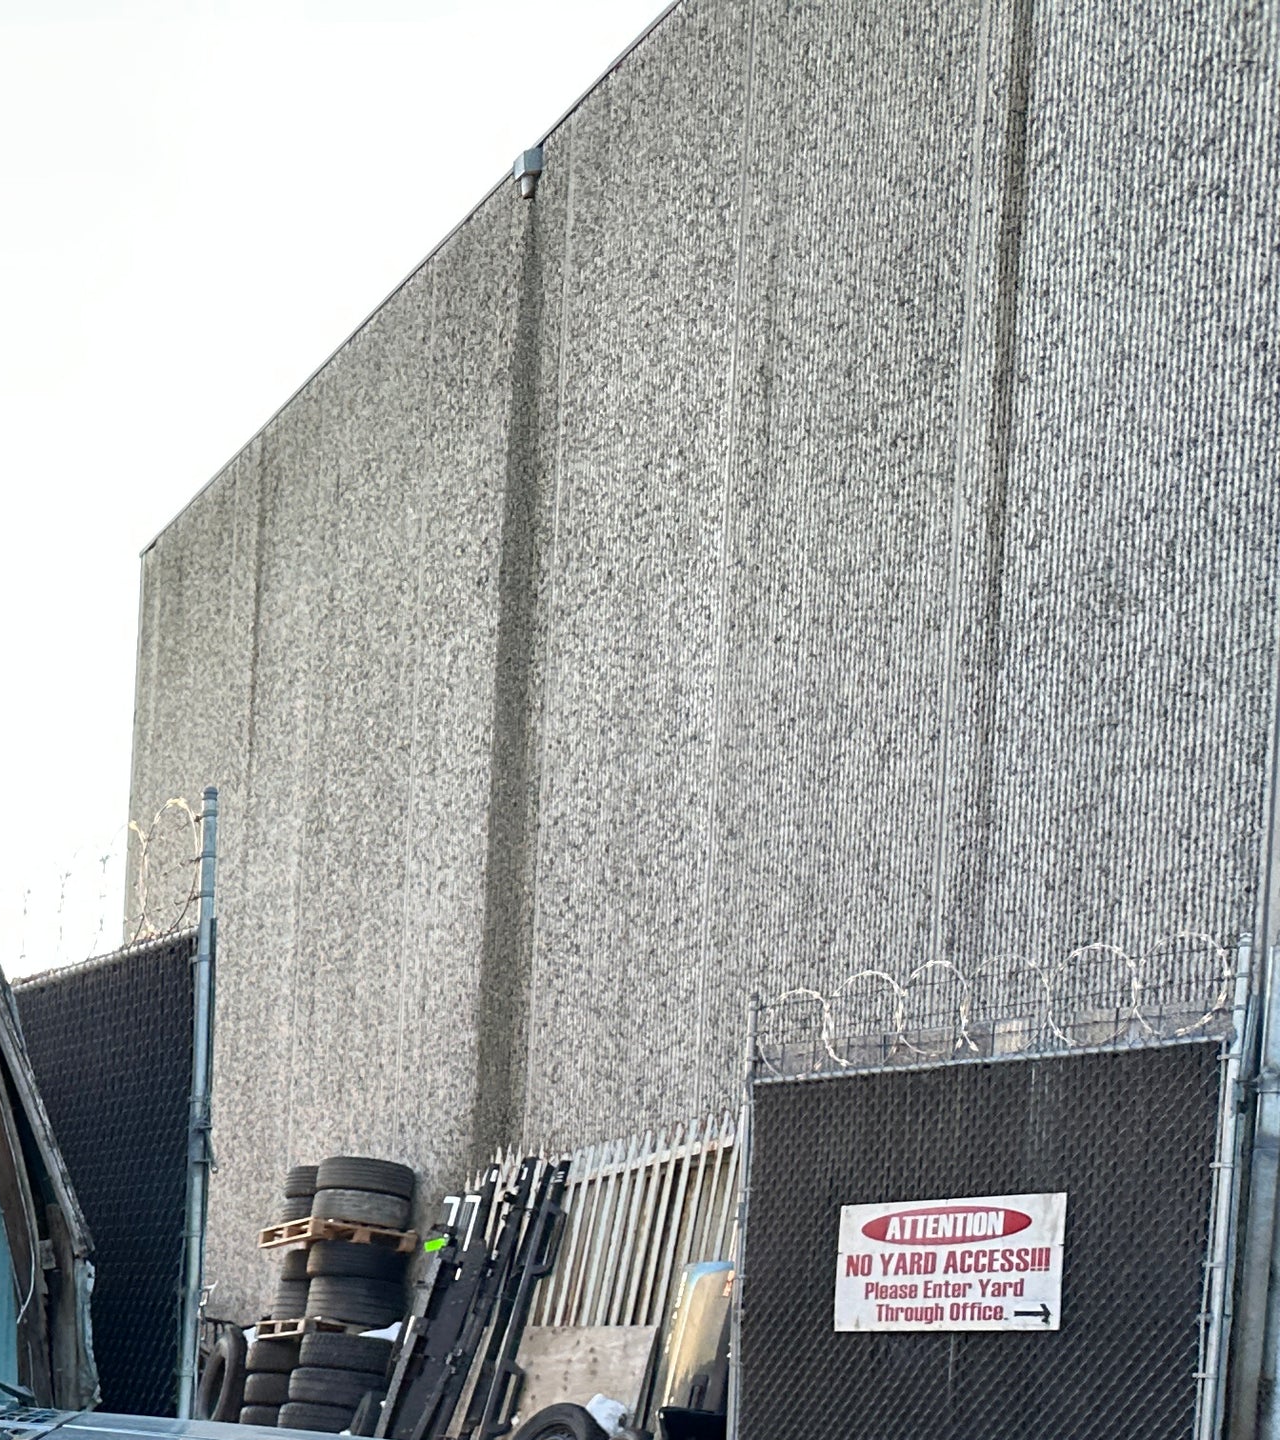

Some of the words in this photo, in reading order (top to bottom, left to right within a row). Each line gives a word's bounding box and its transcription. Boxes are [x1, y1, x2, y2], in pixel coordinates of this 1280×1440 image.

[885, 1210, 1005, 1241] ATTENTION
[845, 1254, 873, 1277] NO
[880, 1251, 937, 1277] YARD
[943, 1247, 1052, 1274] ACCESS!!!
[864, 1281, 918, 1300] Please
[923, 1280, 973, 1299] Enter
[978, 1278, 1025, 1298] Yard
[876, 1304, 945, 1325] Through
